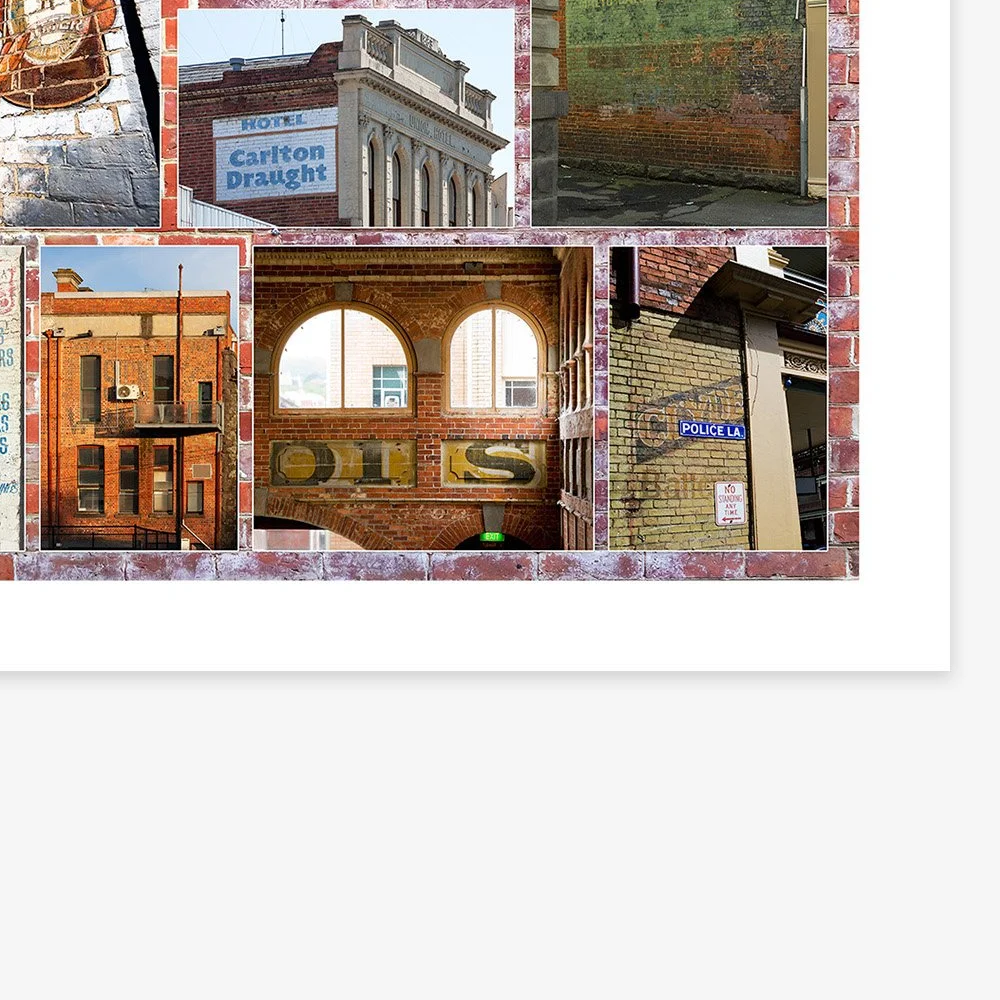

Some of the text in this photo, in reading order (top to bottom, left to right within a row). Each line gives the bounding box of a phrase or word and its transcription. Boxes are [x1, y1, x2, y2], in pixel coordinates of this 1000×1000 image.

[241, 114, 307, 131] HOTEL
[229, 144, 325, 167] Carlton
[226, 163, 328, 190] Draught
[682, 423, 725, 437] POLICE
[724, 485, 736, 493] NO
[485, 532, 499, 540] EXIT
